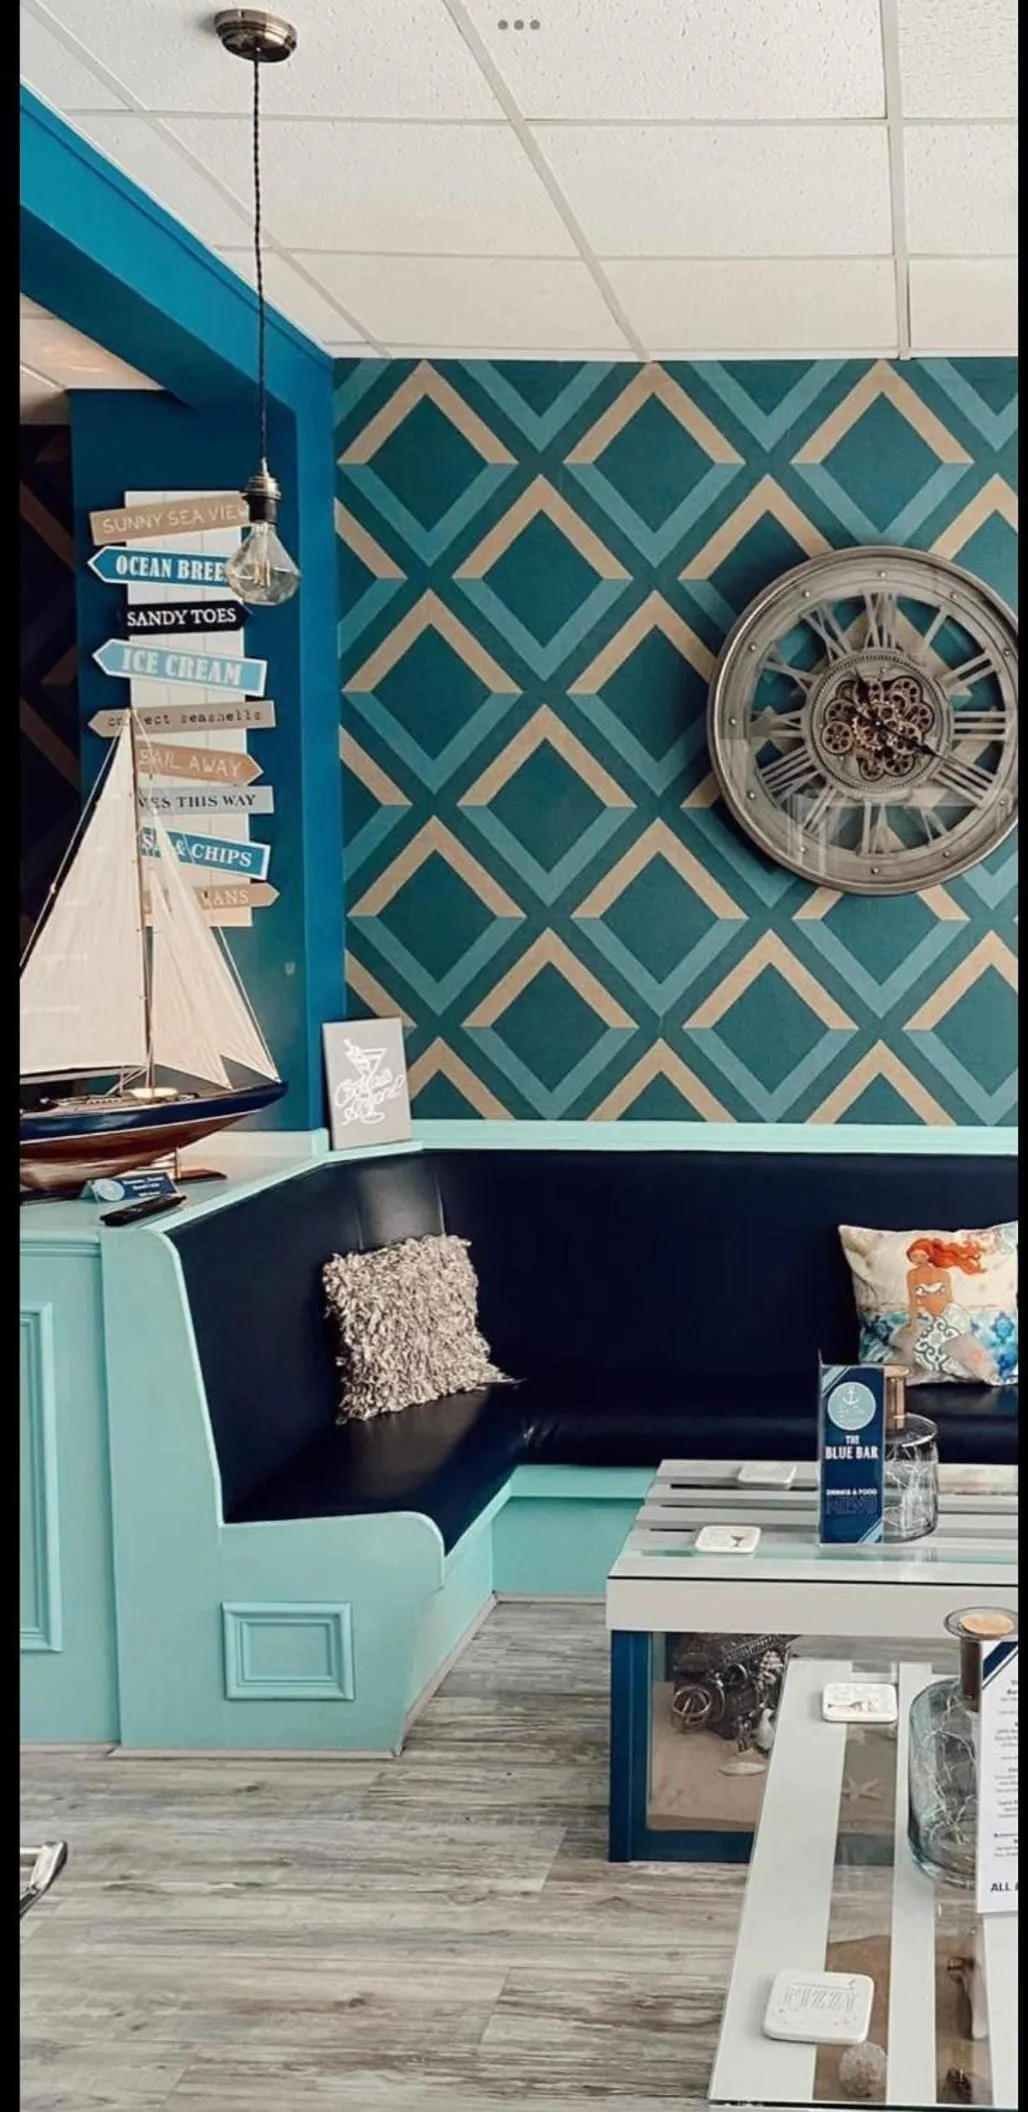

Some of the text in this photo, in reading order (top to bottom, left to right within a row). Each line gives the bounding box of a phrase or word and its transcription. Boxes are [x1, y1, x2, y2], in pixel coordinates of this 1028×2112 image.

[102, 510, 163, 534] SUNNY
[168, 507, 205, 525] SEA
[115, 555, 226, 582] OCEAN BREE
[127, 608, 237, 627] SANDY TOES
[121, 647, 243, 686] ICE CREAM
[181, 709, 262, 723] seashells
[189, 755, 243, 778] AWAY
[176, 796, 218, 807] THIS
[223, 794, 256, 806] WAY
[191, 843, 253, 868] CHIPS
[845, 1435, 860, 1445] THE
[825, 1446, 879, 1459] BLUE BAR
[991, 1881, 1012, 1893] ALL
